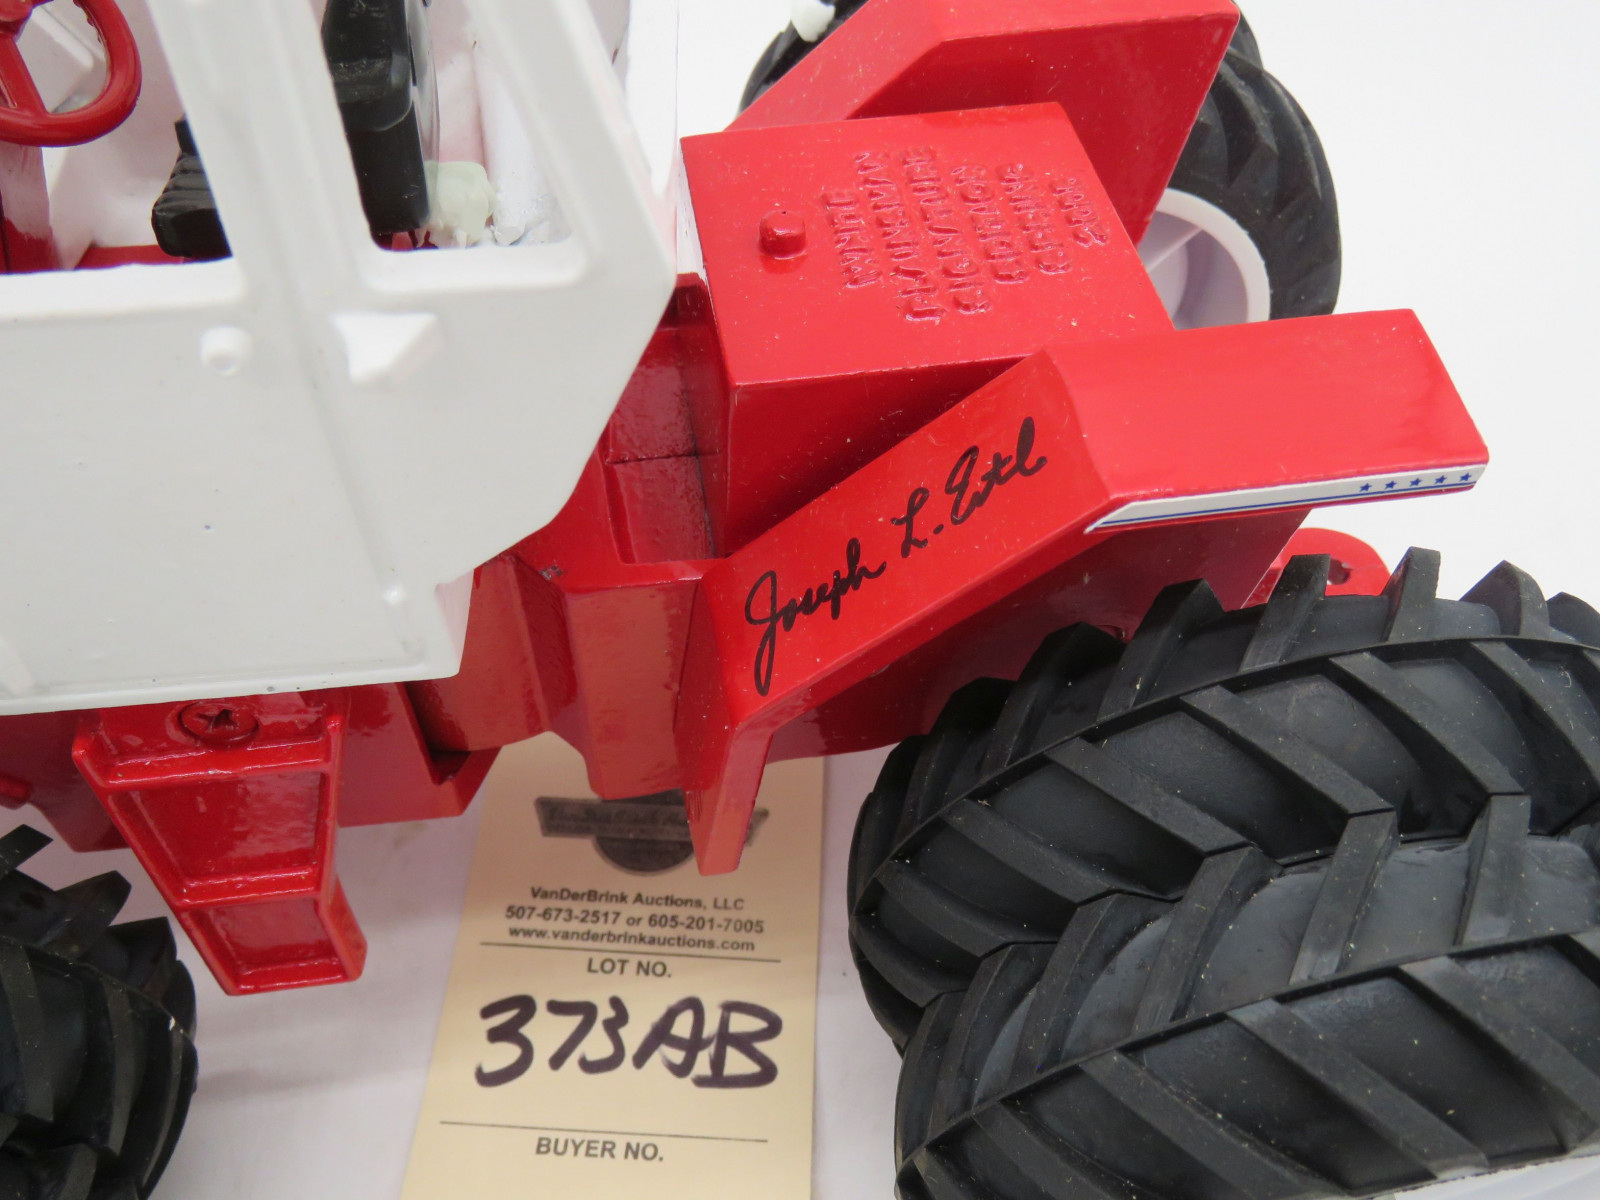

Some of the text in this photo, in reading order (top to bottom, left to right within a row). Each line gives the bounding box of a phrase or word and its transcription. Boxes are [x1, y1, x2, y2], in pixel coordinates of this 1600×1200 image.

[900, 146, 992, 315] SIGNATURE
[949, 164, 1030, 284] EDITION
[745, 537, 886, 697] Joseph
[891, 487, 944, 558] L.
[531, 886, 745, 911] VanDerBrink Auctions, LLC
[505, 905, 765, 934] 507-673-2517 or 605-201-7005
[509, 927, 755, 952] www.vanderbrinkauctions.com
[587, 958, 672, 978] LOT NO.
[474, 994, 783, 1089] 373AB
[536, 1136, 664, 1162] BUYER NO.
